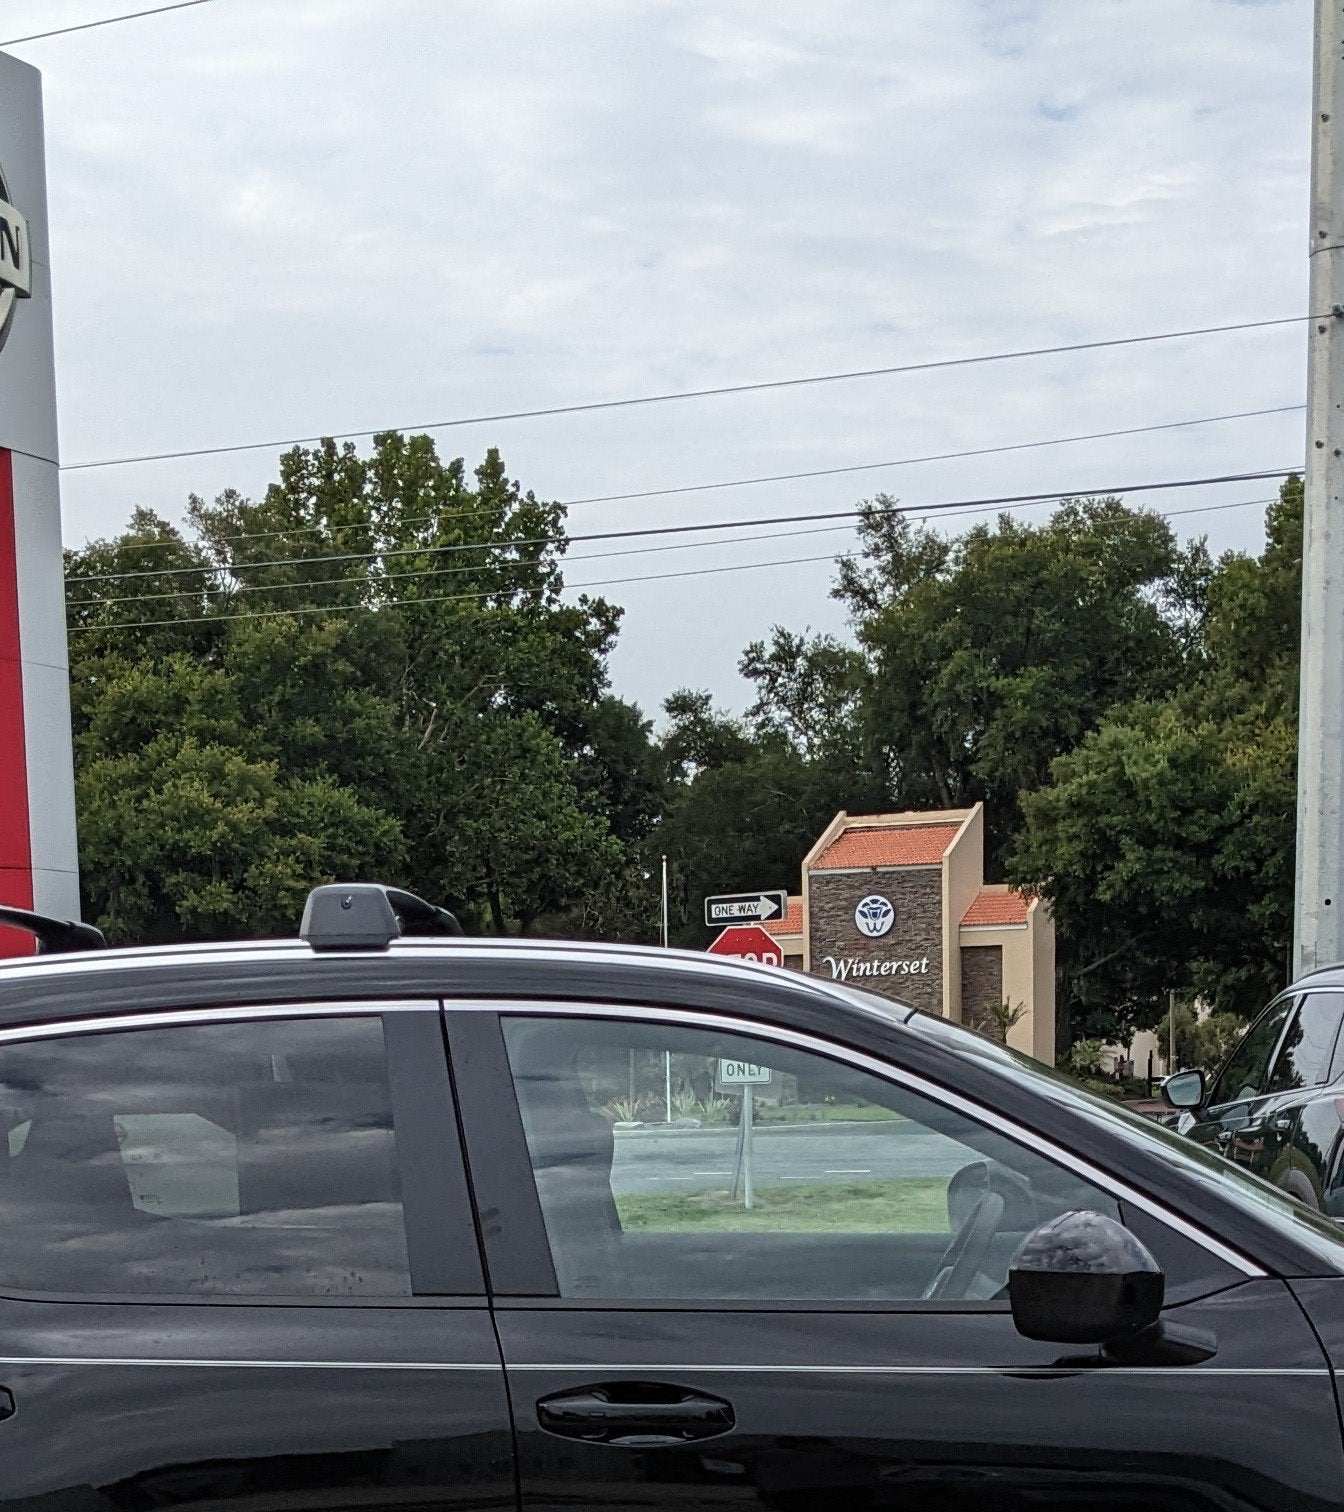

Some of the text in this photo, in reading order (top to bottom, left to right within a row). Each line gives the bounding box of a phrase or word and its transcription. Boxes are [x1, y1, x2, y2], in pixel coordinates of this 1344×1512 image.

[714, 903, 760, 917] ONE WAY
[822, 956, 930, 981] Winterset
[726, 1062, 762, 1077] ONLY
